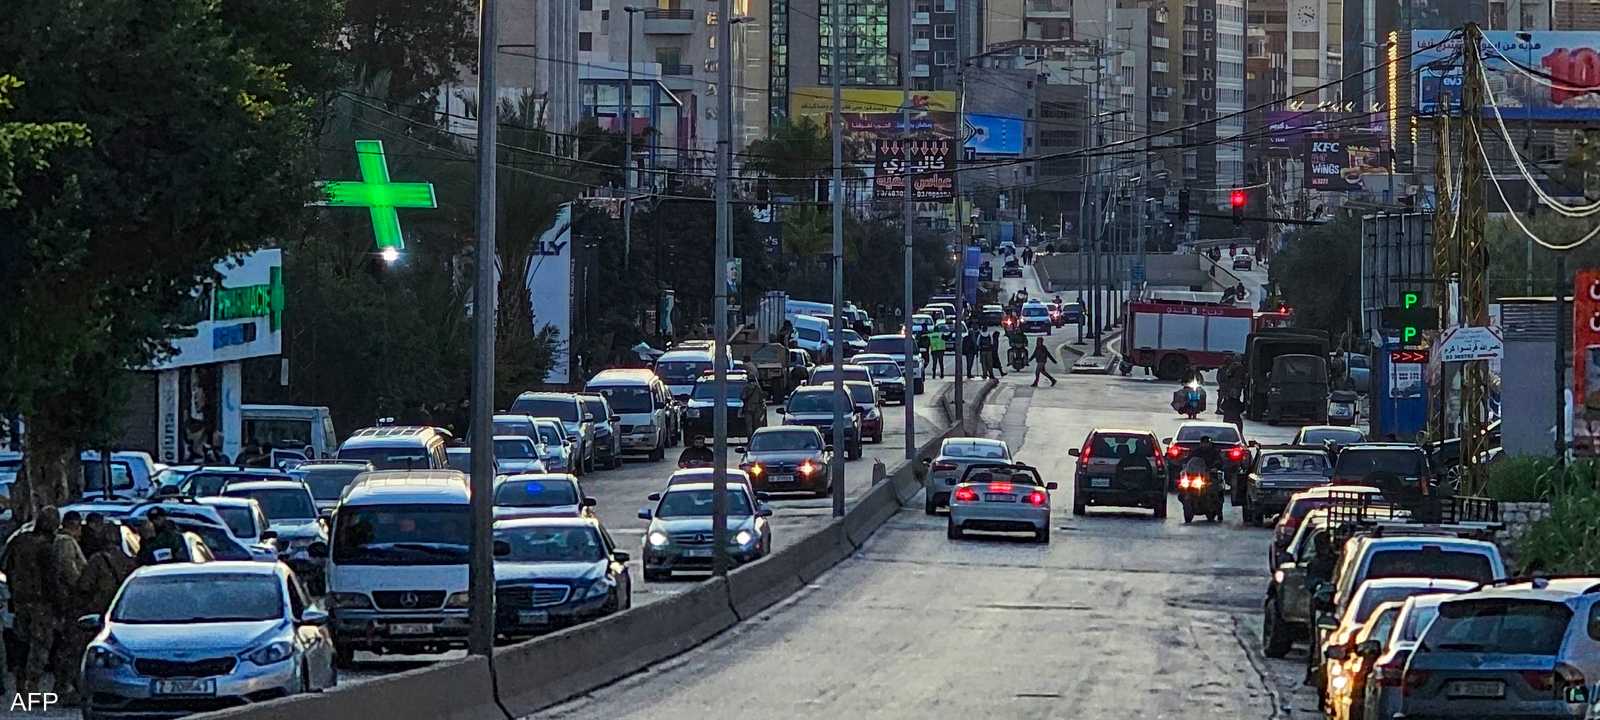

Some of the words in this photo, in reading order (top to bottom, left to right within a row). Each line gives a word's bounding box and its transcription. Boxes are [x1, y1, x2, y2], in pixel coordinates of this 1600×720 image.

[1201, 8, 1214, 121] BEIRUT
[1312, 142, 1340, 152] KFC
[1405, 293, 1418, 309] P
[1404, 326, 1417, 342] P
